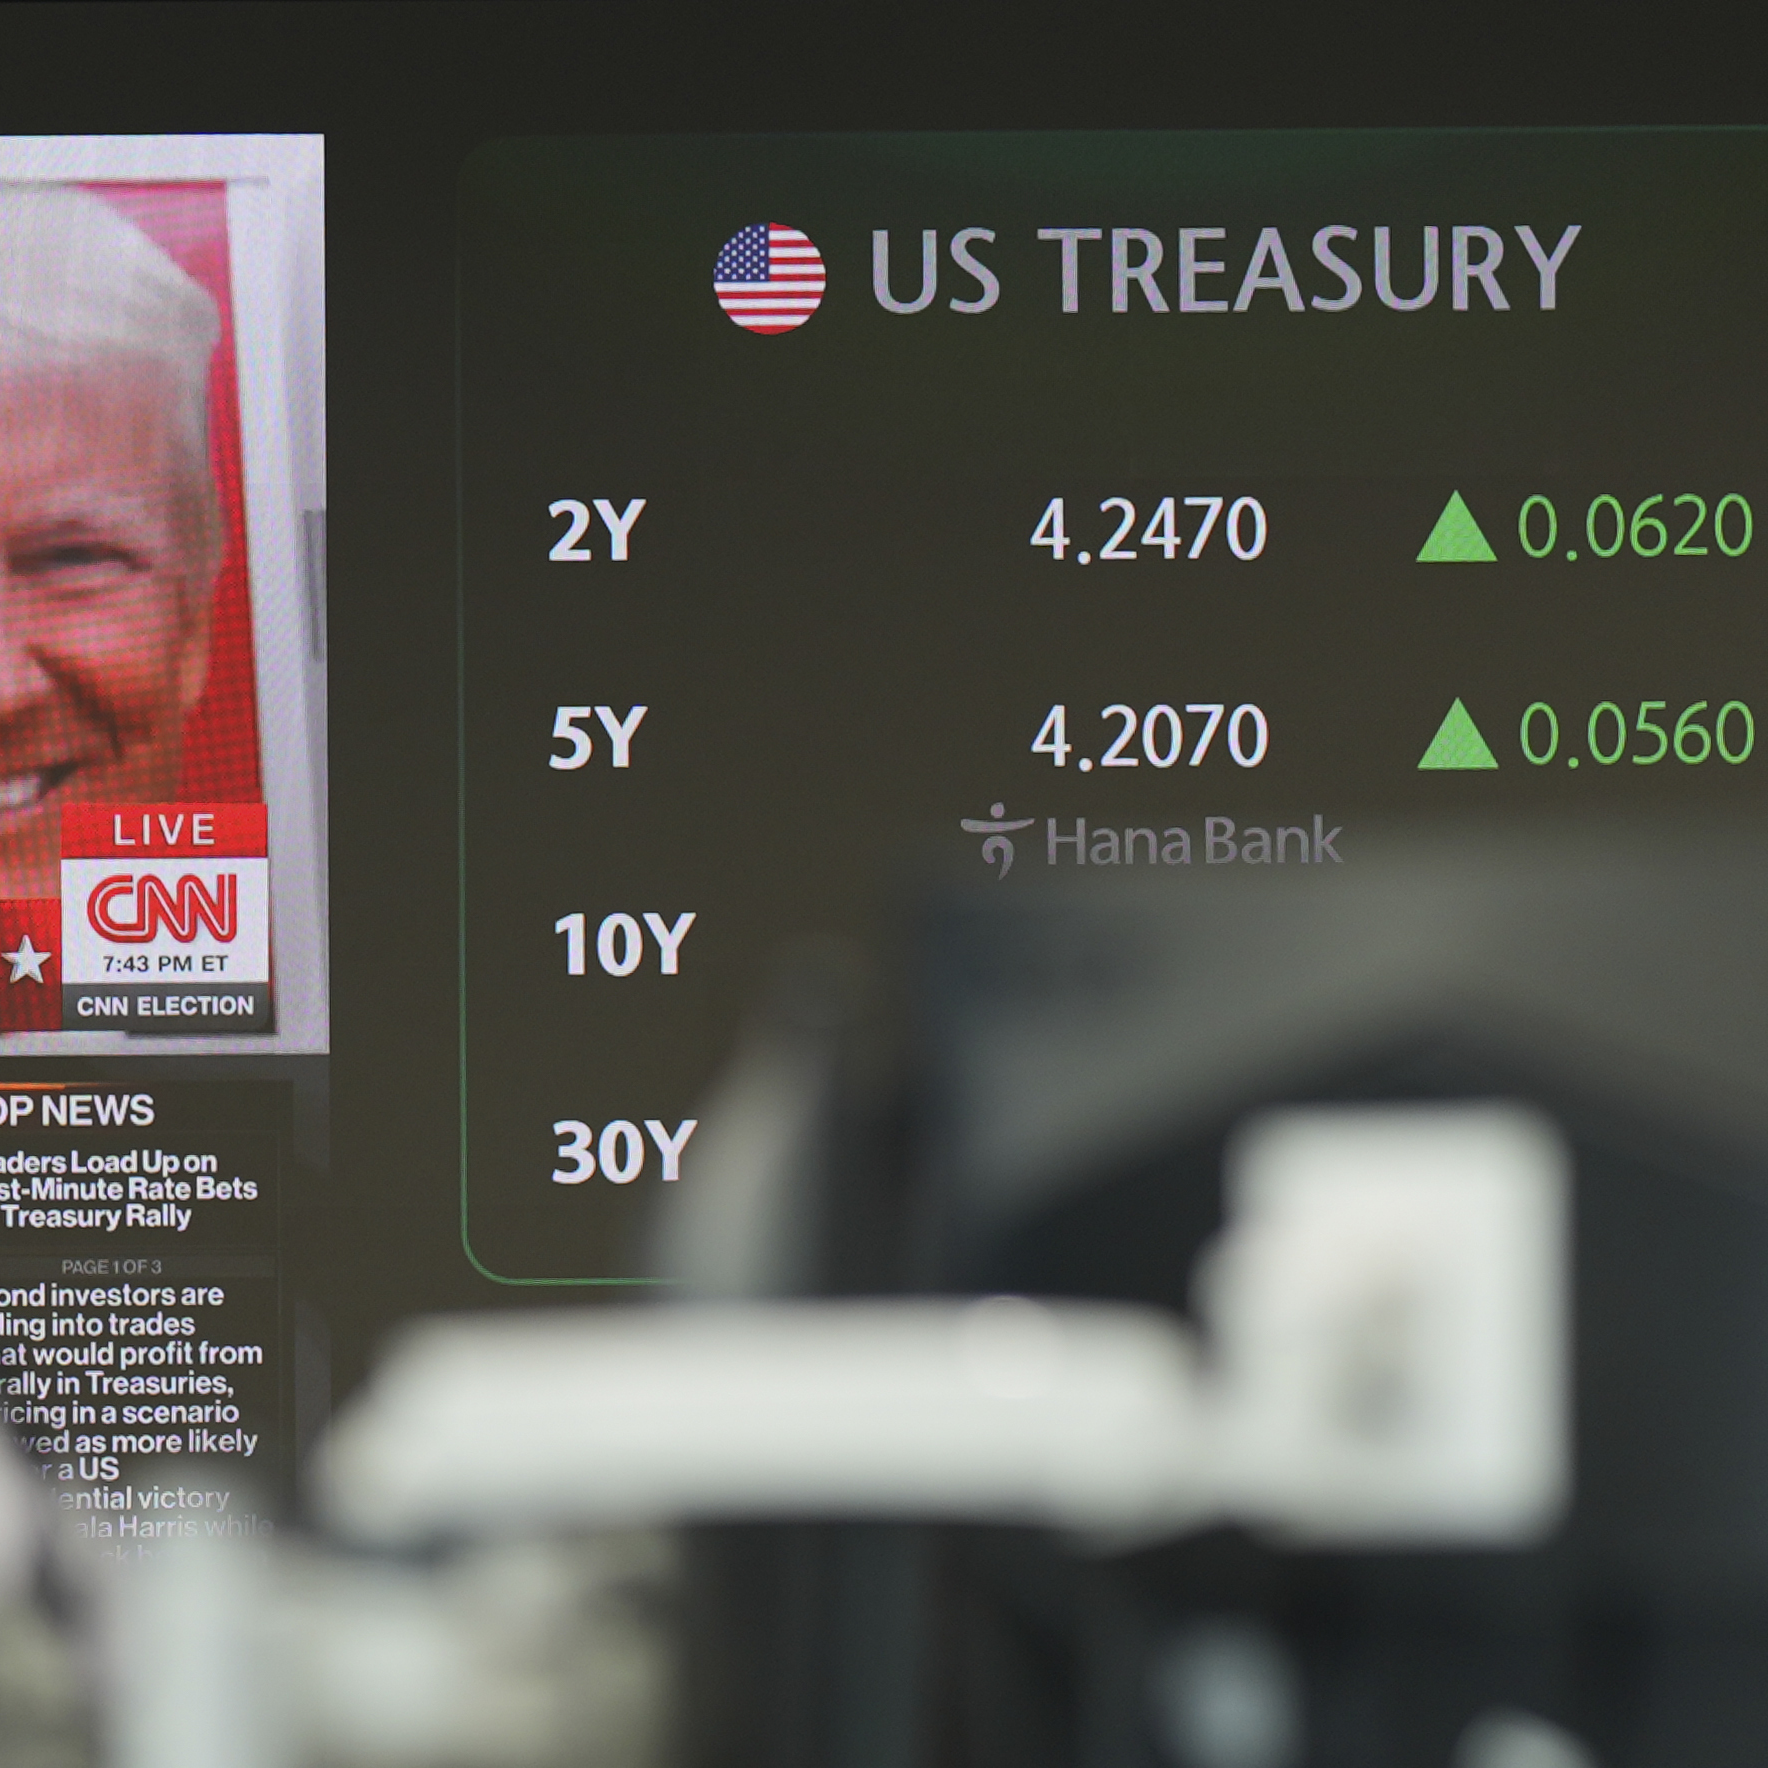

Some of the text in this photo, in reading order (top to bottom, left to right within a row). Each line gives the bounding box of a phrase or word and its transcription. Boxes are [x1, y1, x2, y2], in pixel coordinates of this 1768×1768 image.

[869, 223, 1583, 314] US TREASURY
[548, 492, 1754, 567] 2Y 4.2470 0.0620
[549, 699, 1755, 774] 5Y 4.2070 0.0560
[114, 814, 215, 846] LIVE
[1045, 813, 1344, 867] Hana Bank
[87, 874, 237, 944] CNN
[552, 910, 697, 978] 10Y
[104, 955, 228, 972] 7:43 PM ET
[77, 996, 253, 1016] CNN ELECTION
[42, 1093, 155, 1126] NEWS
[71, 1150, 138, 1173] Load
[143, 1150, 179, 1177] Up
[188, 1154, 217, 1173] on
[551, 1117, 698, 1184] 30Y
[129, 1177, 191, 1200] Rate
[196, 1177, 258, 1199] Bets
[1, 1204, 121, 1232] Treasury
[127, 1204, 192, 1232] Rally
[62, 1260, 162, 1275] PAGE 1 OF 3
[51, 1283, 176, 1307] investors
[181, 1287, 224, 1306] are
[51, 1313, 103, 1336] into
[109, 1312, 195, 1336] trades
[33, 1342, 114, 1366] would
[120, 1342, 193, 1370] profit
[199, 1341, 263, 1365] from
[57, 1372, 79, 1395] in
[85, 1370, 234, 1398] Treasuries,
[72, 1401, 95, 1424] in
[102, 1405, 117, 1423] a
[122, 1399, 240, 1424] scenario
[13, 1429, 258, 1456] wed as more likely
[58, 1461, 74, 1480] a
[79, 1457, 120, 1481] US
[138, 1487, 230, 1512] victory
[119, 1516, 197, 1538] Harris
